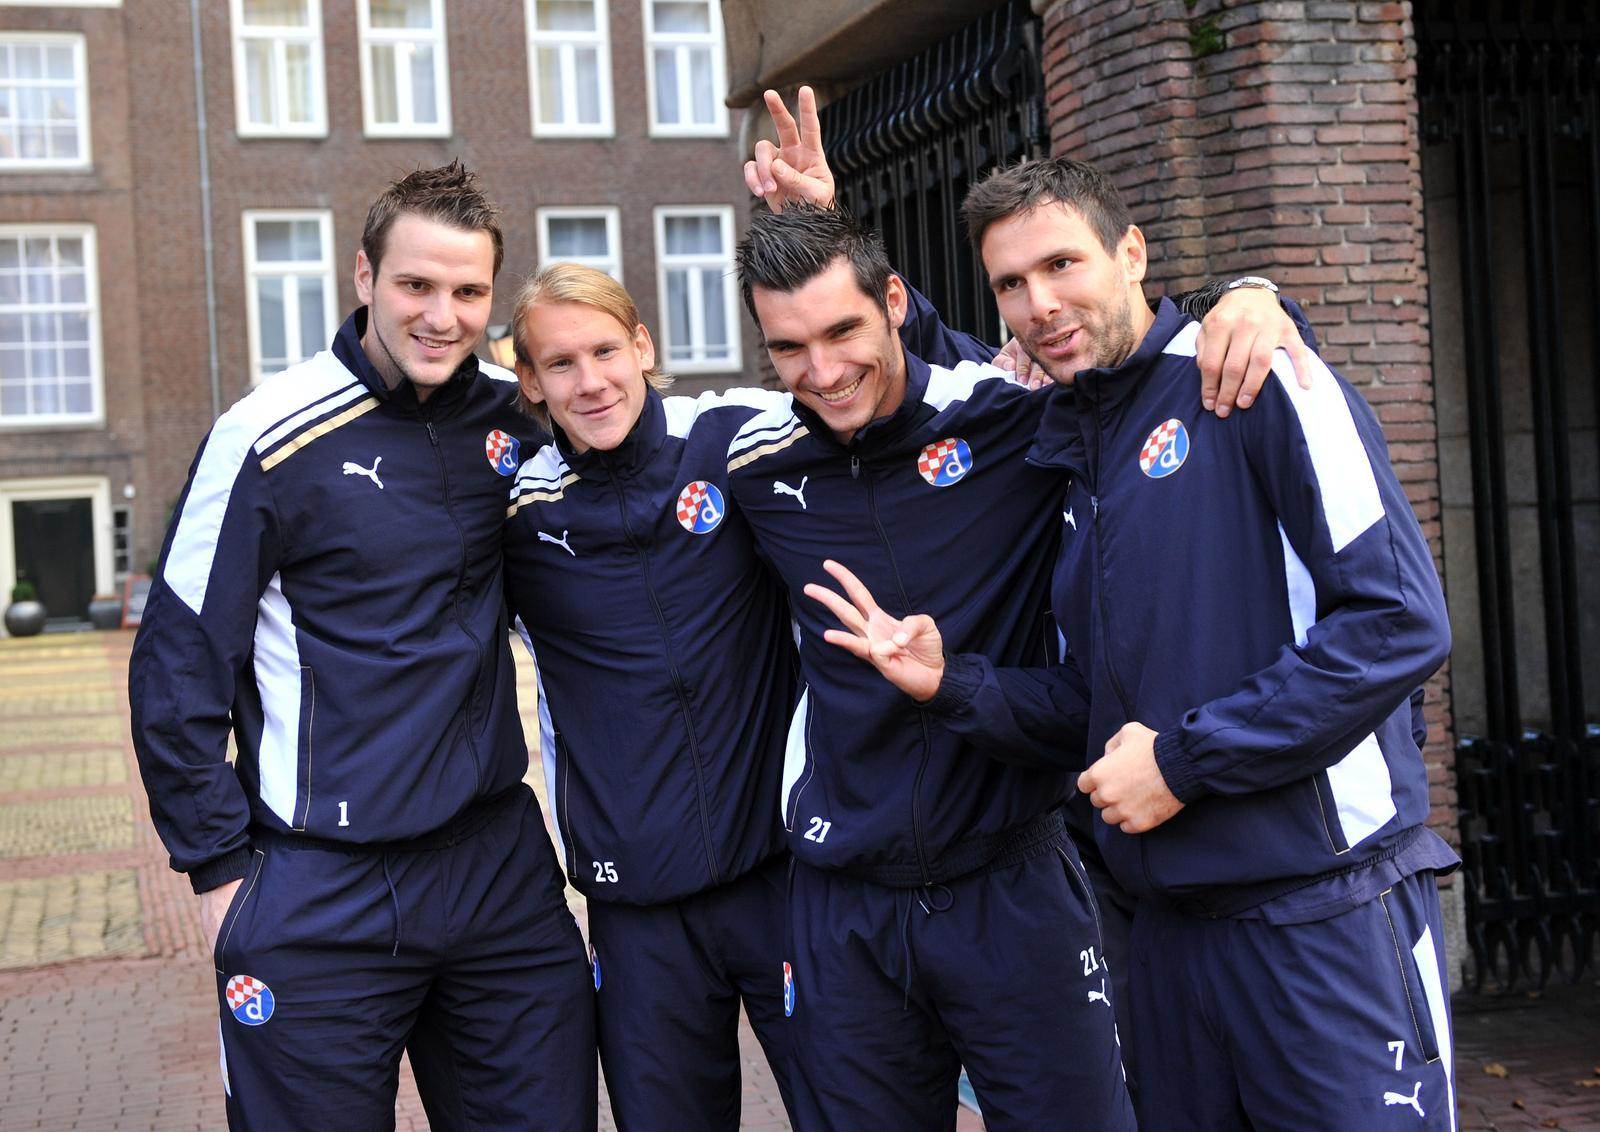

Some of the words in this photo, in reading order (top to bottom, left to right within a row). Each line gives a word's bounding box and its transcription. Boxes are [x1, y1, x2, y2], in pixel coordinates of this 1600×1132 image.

[337, 800, 350, 827] 1
[803, 816, 832, 844] 21
[592, 861, 619, 884] 25
[1079, 946, 1100, 977] 21
[246, 993, 265, 1021] d
[1387, 1040, 1405, 1071] 7
